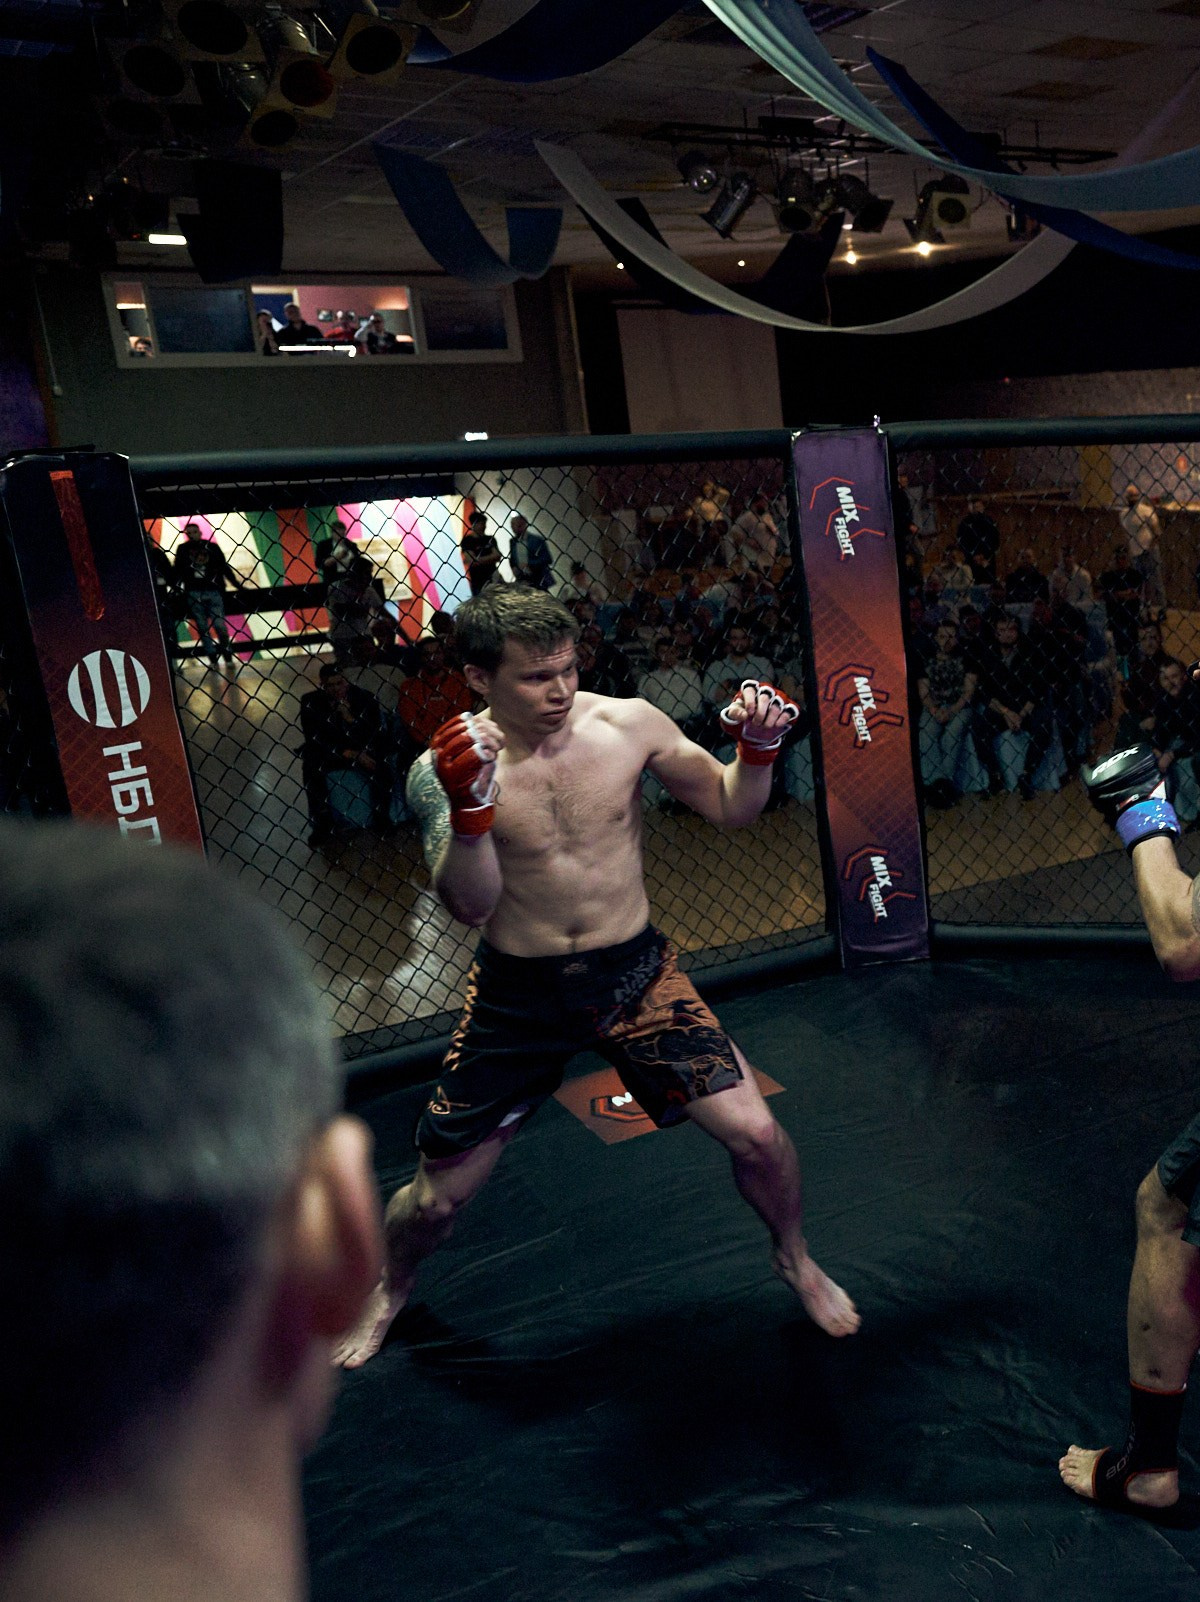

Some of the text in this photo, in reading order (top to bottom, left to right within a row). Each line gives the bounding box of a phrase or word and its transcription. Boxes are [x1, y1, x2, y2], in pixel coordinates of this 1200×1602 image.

[836, 486, 860, 523] MIX
[834, 516, 855, 556] FIGHT
[853, 676, 877, 712] MIX
[852, 705, 872, 742] FIGHT
[1091, 746, 1140, 781] RDX
[870, 855, 893, 889] MIX
[868, 883, 888, 918] FIGHT
